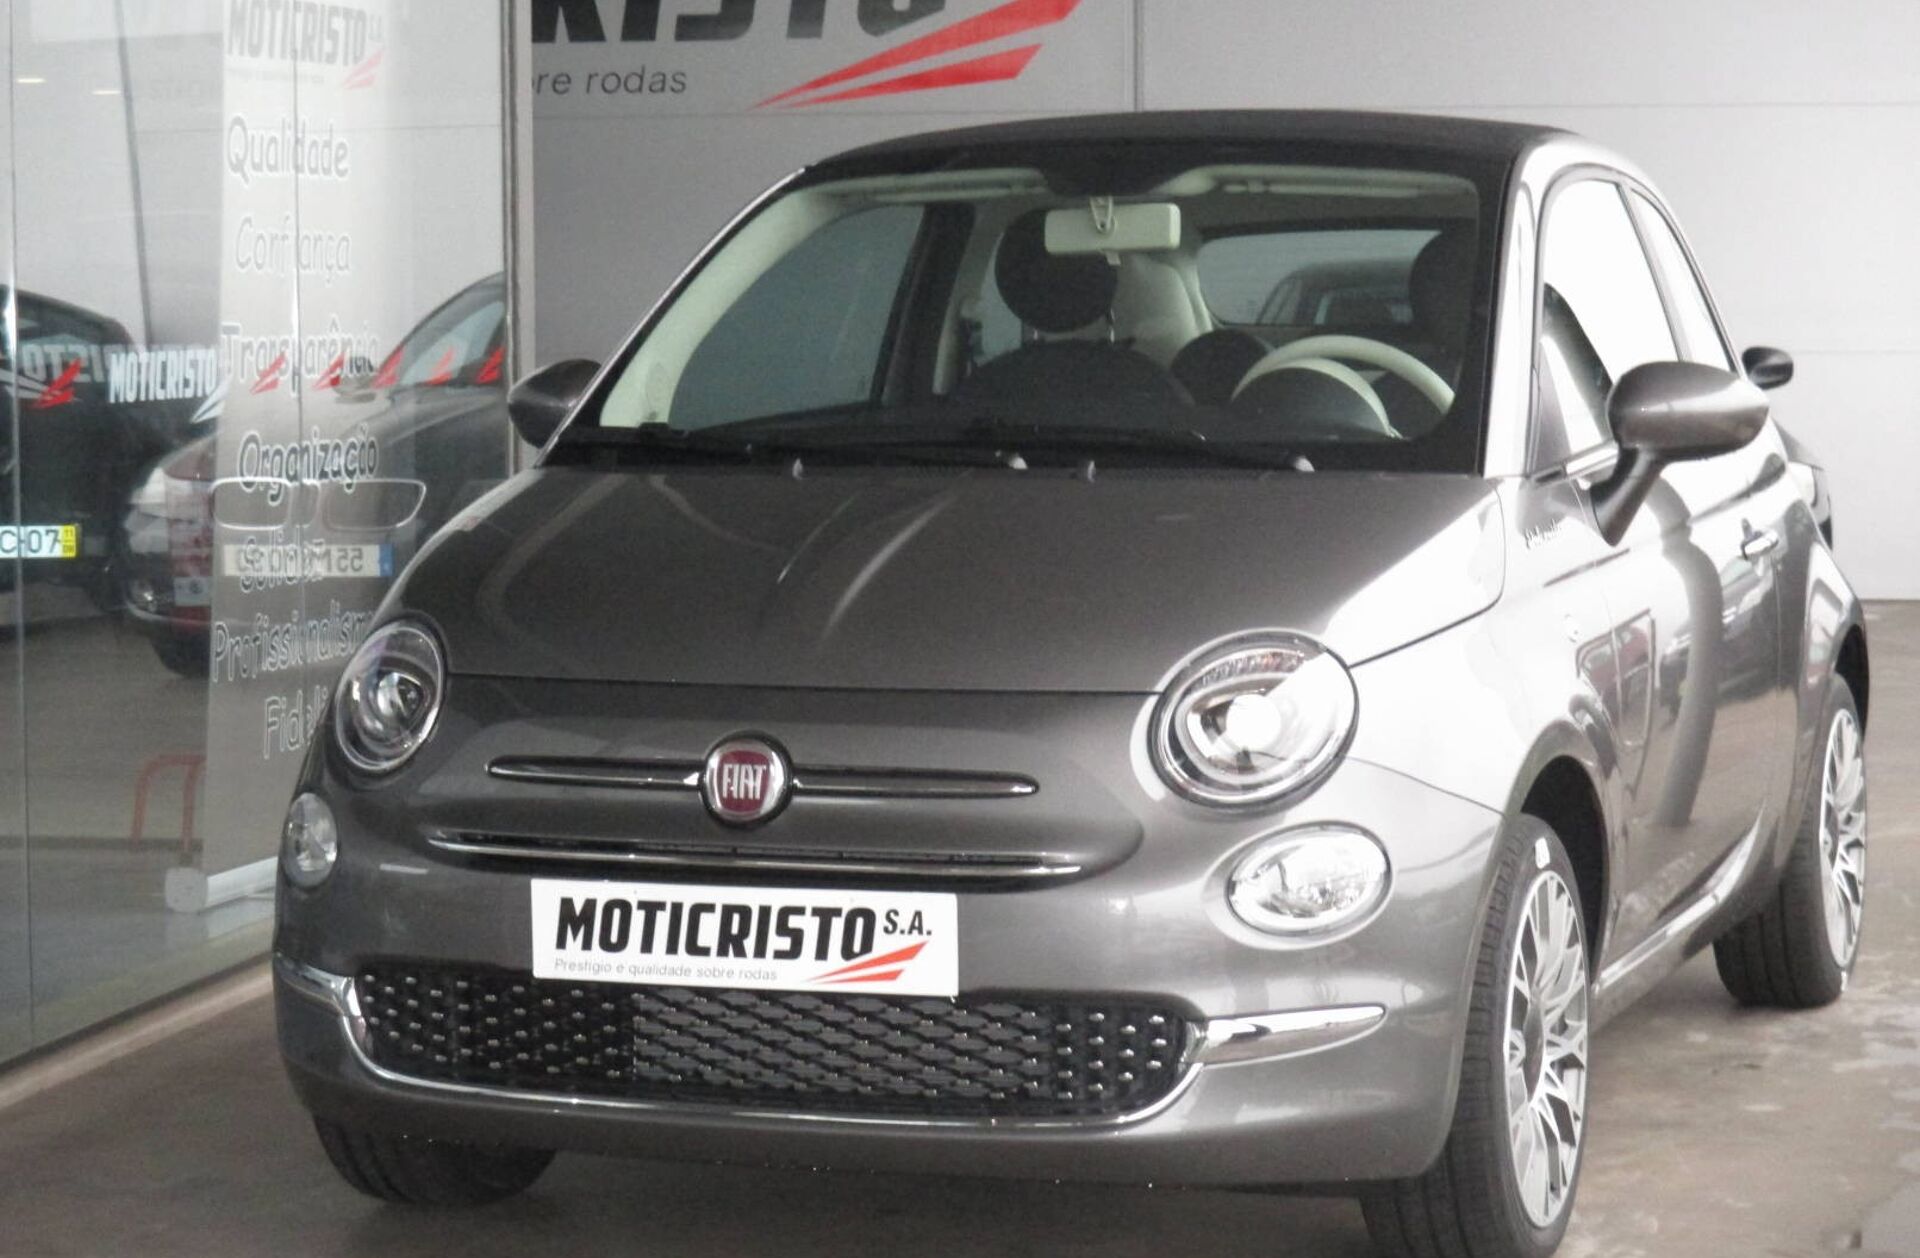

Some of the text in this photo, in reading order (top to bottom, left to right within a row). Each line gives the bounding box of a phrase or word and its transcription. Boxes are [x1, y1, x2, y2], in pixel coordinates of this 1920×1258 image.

[531, 64, 688, 94] re rodas
[227, 115, 351, 184] Qualidade
[235, 215, 351, 284] Confança
[109, 349, 218, 403] MOTICRISTO
[722, 763, 767, 800] FIAT
[556, 896, 933, 962] MOTICRISTO S.A.
[629, 960, 692, 977] qualidade
[697, 962, 735, 979] sobre
[738, 964, 778, 981] rodas
